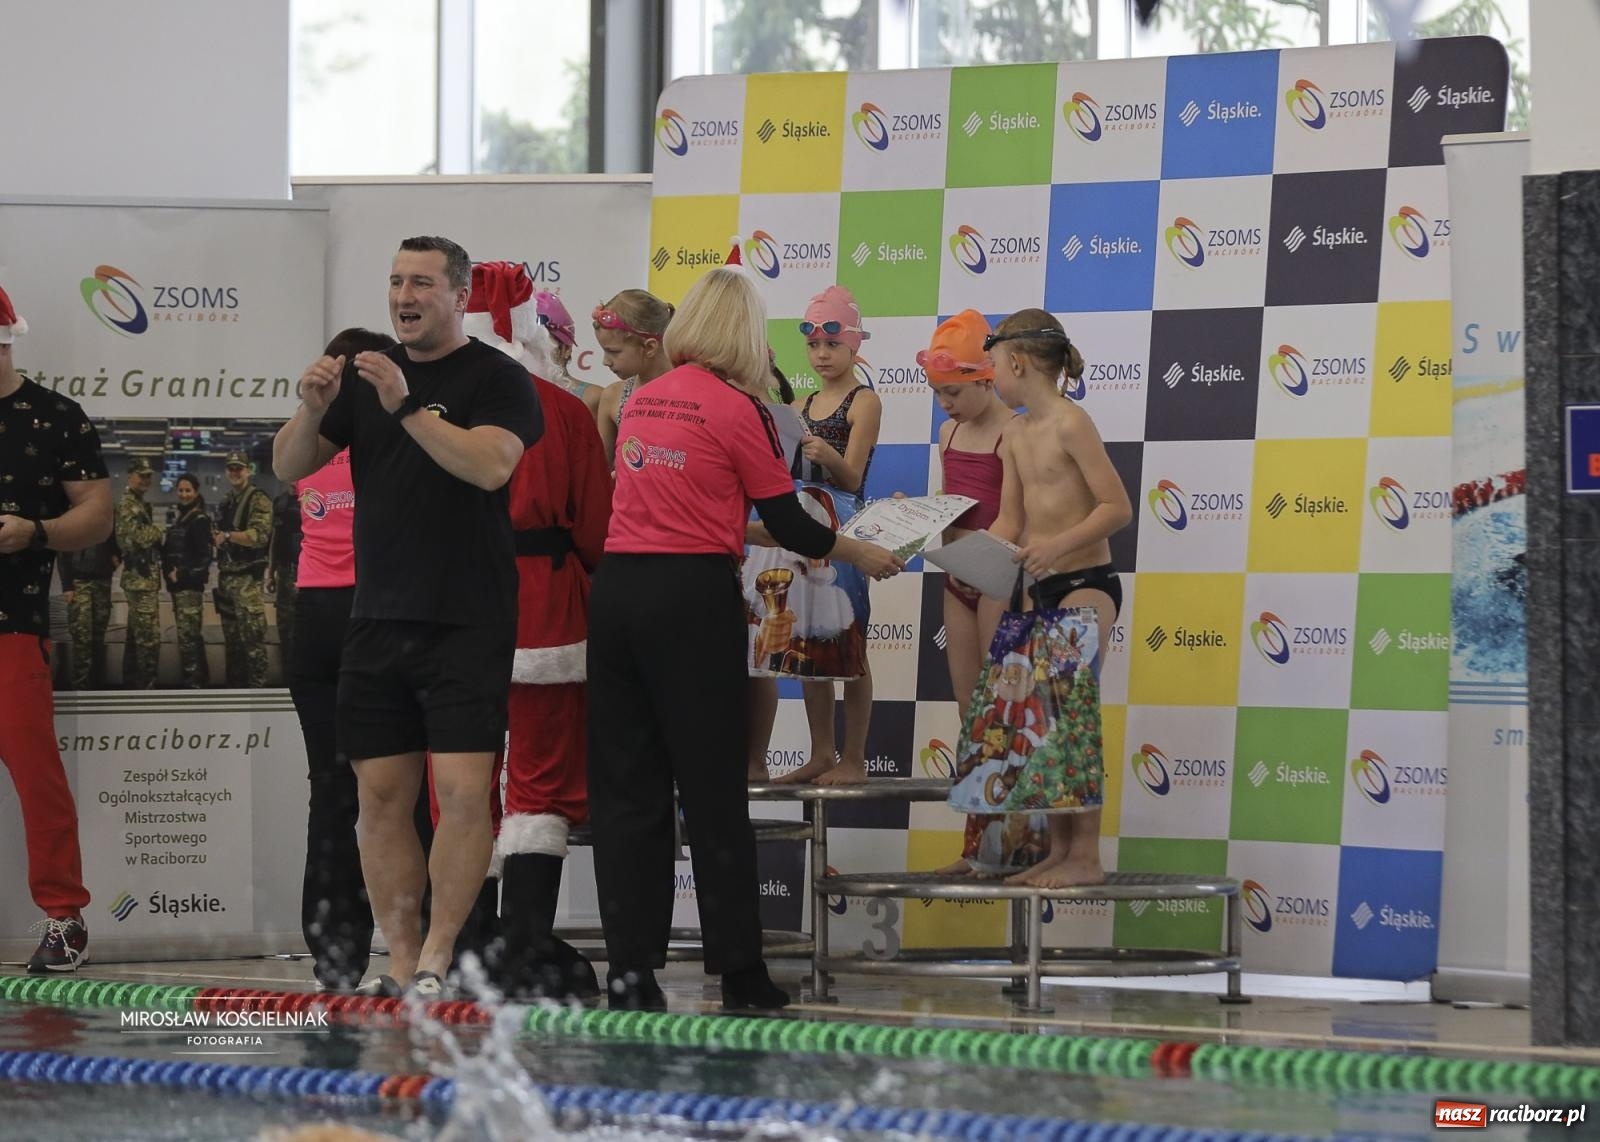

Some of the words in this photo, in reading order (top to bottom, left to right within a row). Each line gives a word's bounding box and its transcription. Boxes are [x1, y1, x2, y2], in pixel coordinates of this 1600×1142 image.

[1329, 89, 1385, 109] ZSOMS
[1437, 85, 1495, 110] Śląskie.
[1104, 102, 1157, 121] ZSOMS
[1207, 99, 1262, 123] Śląskie.
[691, 120, 738, 137] ZSOMS
[782, 118, 831, 141] Śląskie.
[892, 113, 942, 131] ZSOMS
[989, 111, 1041, 133] Śląskie.
[990, 236, 1041, 254] ZSOMS
[1089, 234, 1142, 258] Śląskie.
[1208, 228, 1261, 247] ZSOMS
[1312, 225, 1368, 250] Śląskie.
[676, 247, 723, 271] Śląskie.
[783, 242, 831, 260] ZSOMS
[877, 243, 928, 265] Śląskie.
[153, 286, 239, 309] ZSOMS
[153, 311, 240, 323] RACIBÓRZ
[1089, 362, 1141, 381] ZSOMS
[1191, 361, 1245, 386] Śląskie.
[1312, 357, 1366, 375] ZSOMS
[16, 368, 109, 397] traż
[878, 368, 927, 385] ZSOMS
[1191, 493, 1244, 511] ZSOMS
[1294, 495, 1349, 517] Śląskie.
[866, 624, 913, 640] ZSOMS
[1173, 628, 1227, 649] Śląskie.
[1293, 627, 1347, 646] ZSOMS
[58, 727, 271, 754] smsraciborz.pl
[766, 750, 804, 767] SOMS
[1173, 759, 1226, 777] ZSOMS
[123, 770, 168, 785] Zespół
[171, 768, 207, 782] Szkół
[1276, 763, 1330, 786] Śląskie.
[1394, 766, 1447, 785] ZSOMS
[98, 789, 232, 806] Ogólnokształcących
[124, 811, 207, 824] Mistrzostwa
[124, 831, 207, 846] Sportowego
[125, 855, 136, 865] w
[140, 852, 207, 866] Raciborzu
[149, 891, 226, 918] Śląskie.
[1275, 898, 1329, 917] ZSOMS
[862, 897, 900, 960] 3
[1379, 908, 1434, 932] Śląskie.
